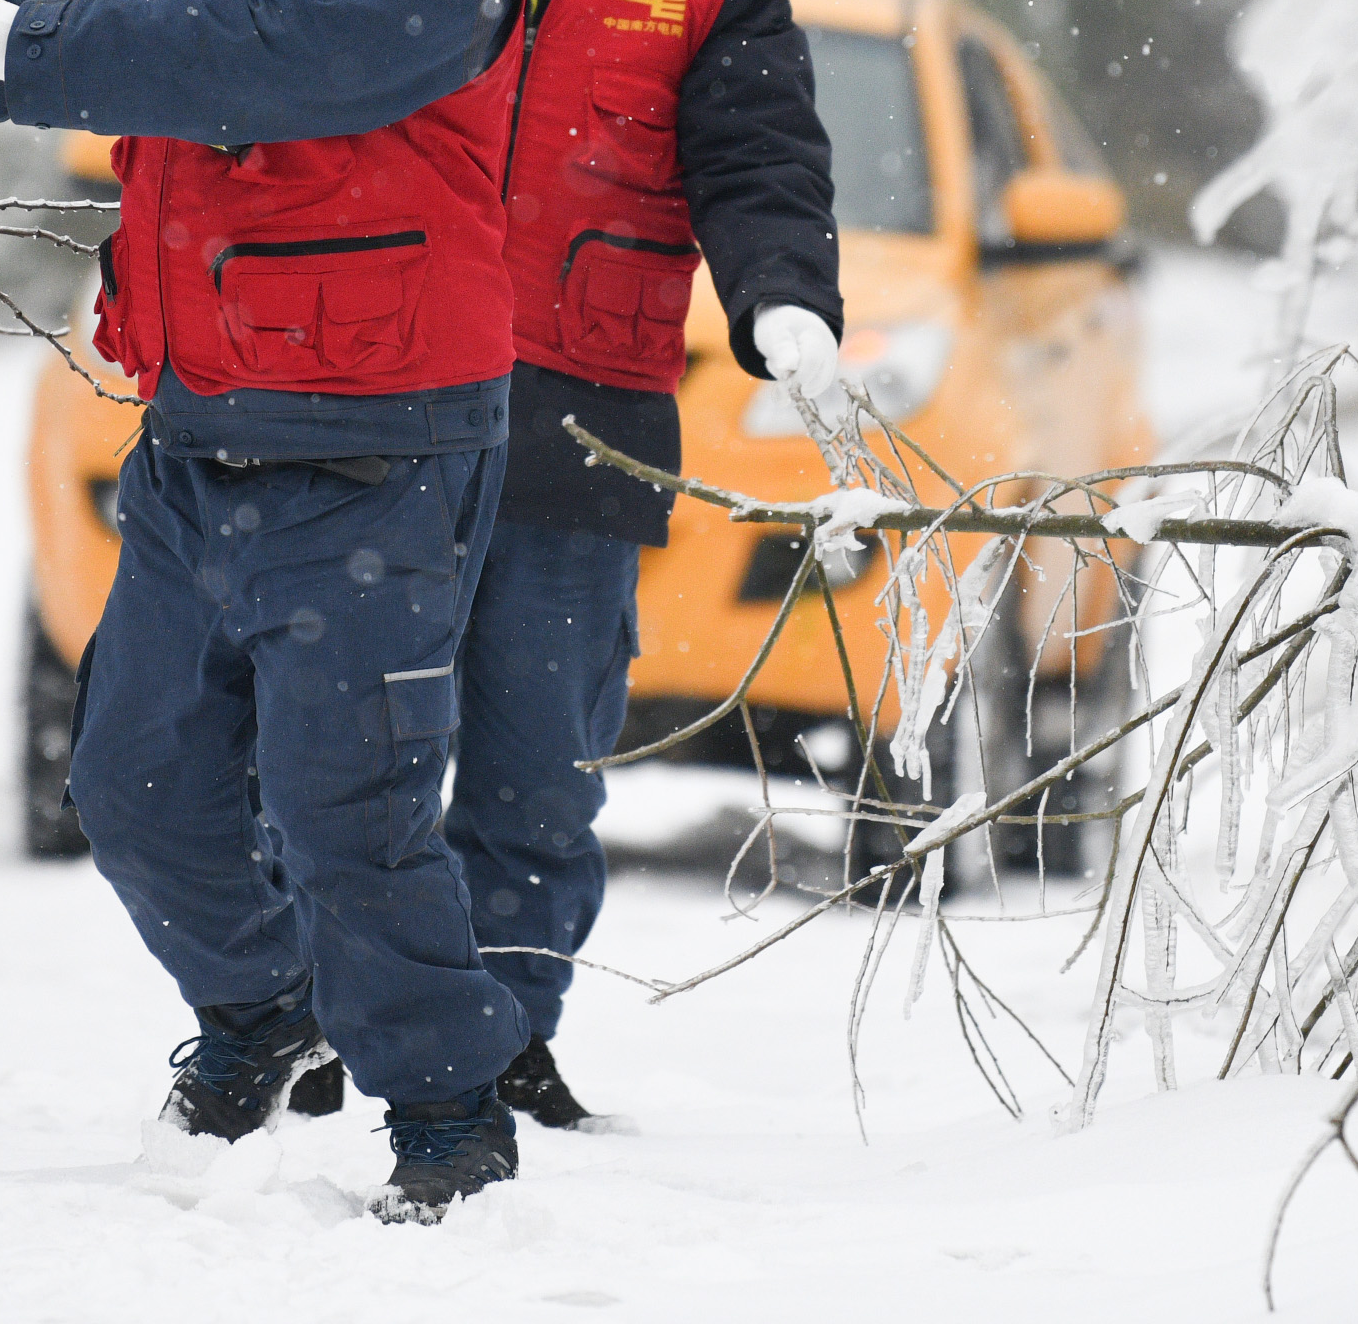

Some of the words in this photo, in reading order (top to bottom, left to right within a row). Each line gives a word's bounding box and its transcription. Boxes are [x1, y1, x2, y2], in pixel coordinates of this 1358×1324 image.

[603, 16, 683, 38] 中国南方电网
